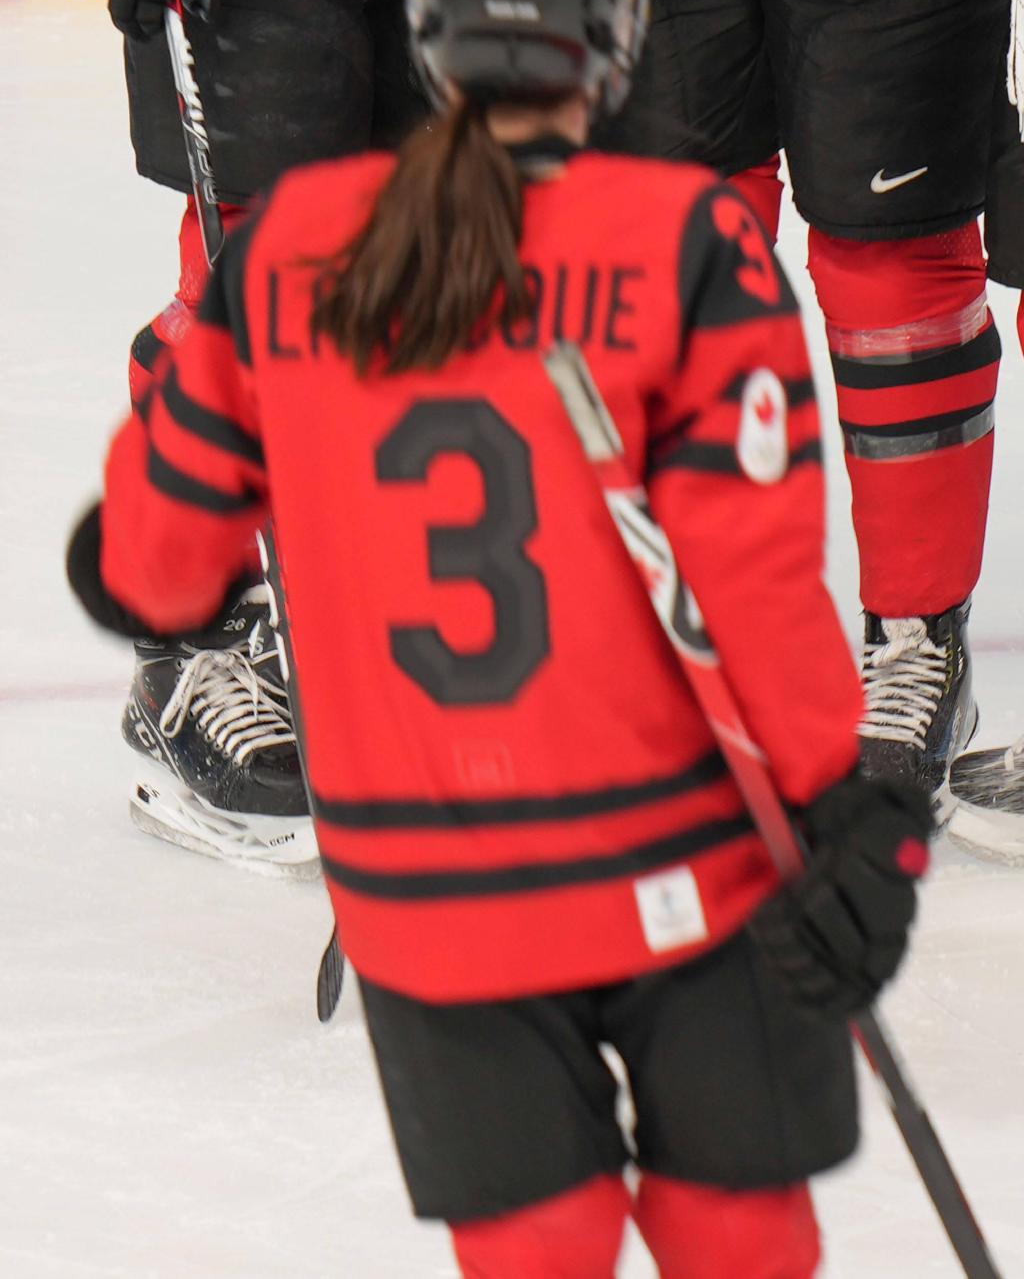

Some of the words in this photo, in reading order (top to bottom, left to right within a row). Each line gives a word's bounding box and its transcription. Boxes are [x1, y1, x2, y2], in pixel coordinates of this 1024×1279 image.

[711, 196, 780, 306] 3
[374, 396, 553, 707] 3
[223, 617, 247, 631] 26
